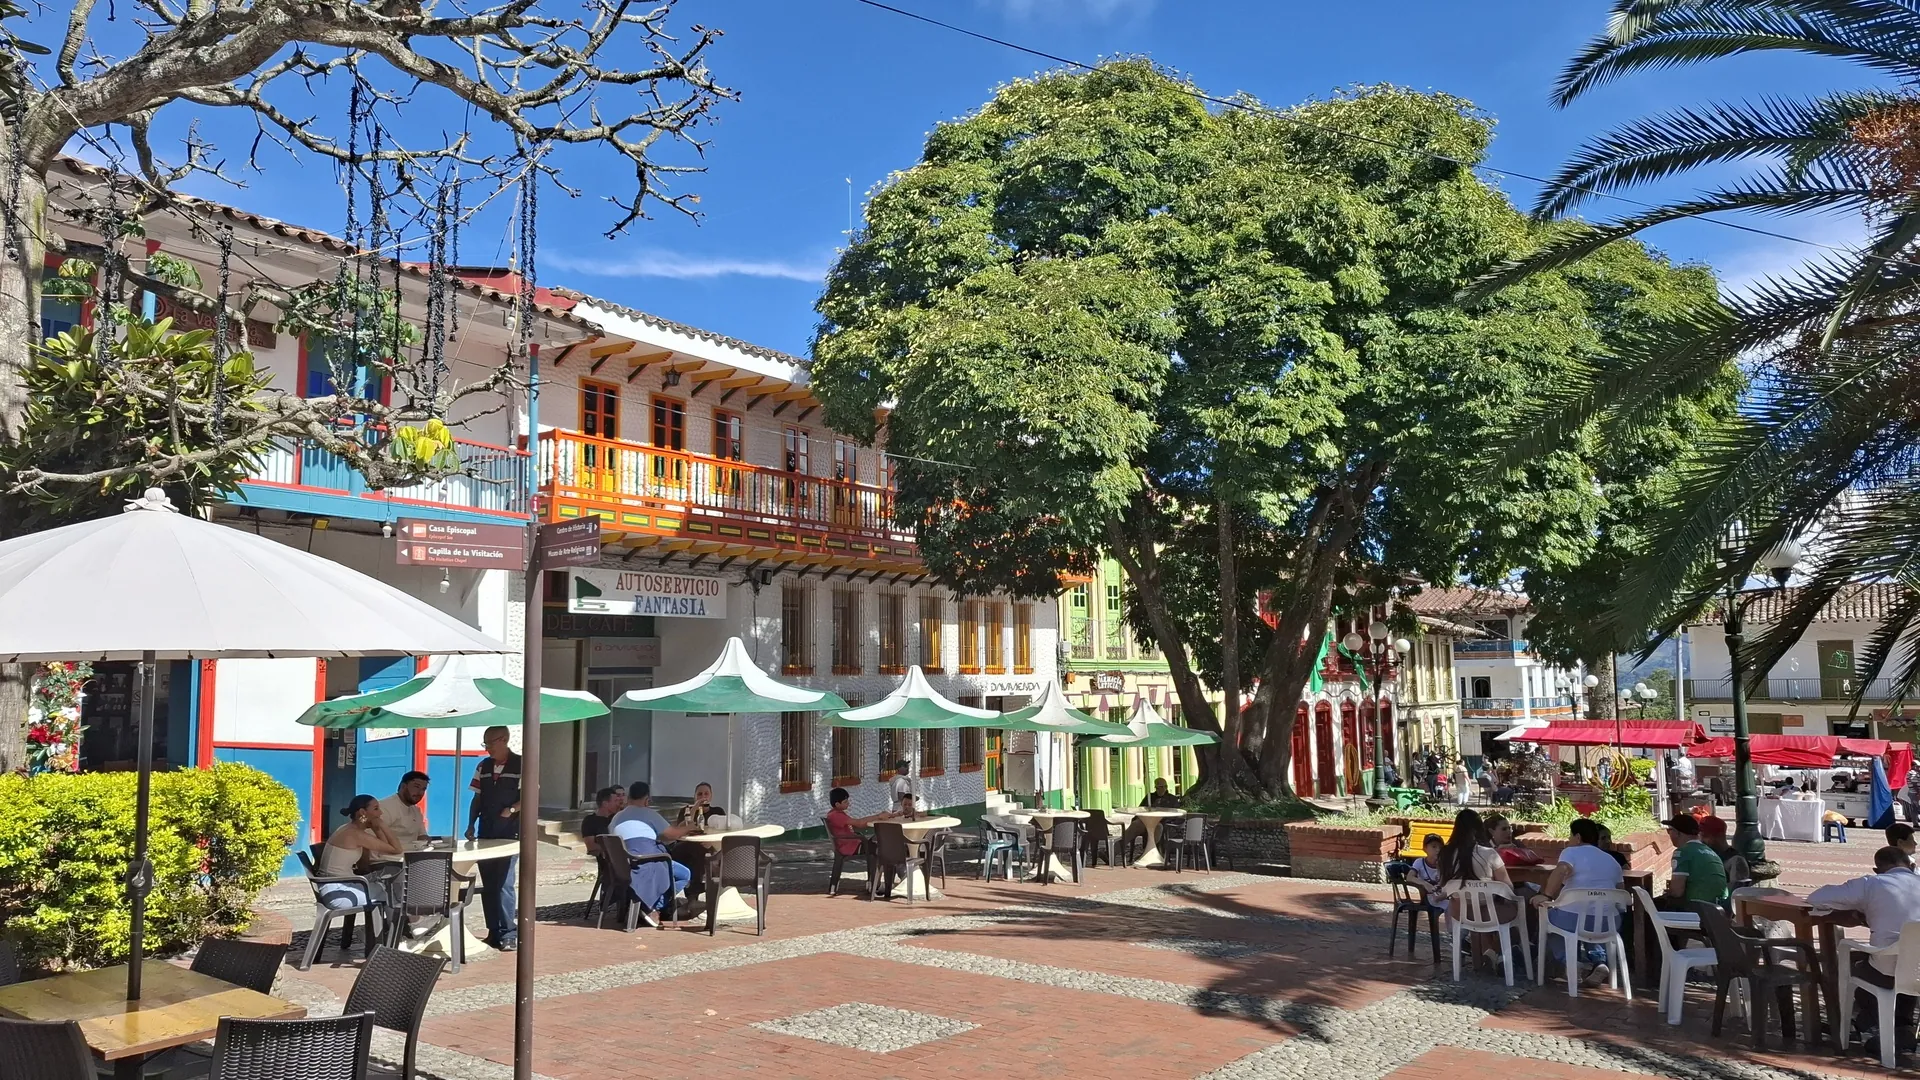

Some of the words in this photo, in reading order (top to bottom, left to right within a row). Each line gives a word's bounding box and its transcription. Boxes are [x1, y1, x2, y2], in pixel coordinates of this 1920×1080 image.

[429, 525, 444, 533] Casa
[446, 525, 477, 535] Episcopal
[568, 525, 573, 533] de
[573, 523, 585, 531] Historia
[428, 547, 452, 556] Capilla
[453, 548, 462, 556] de
[471, 549, 503, 558] Visitación
[548, 549, 558, 557] Museo
[570, 546, 585, 555] Religioso
[616, 573, 719, 596] AUTOSERVICIO
[634, 595, 706, 616] FANTASIA
[547, 614, 584, 631] DEL
